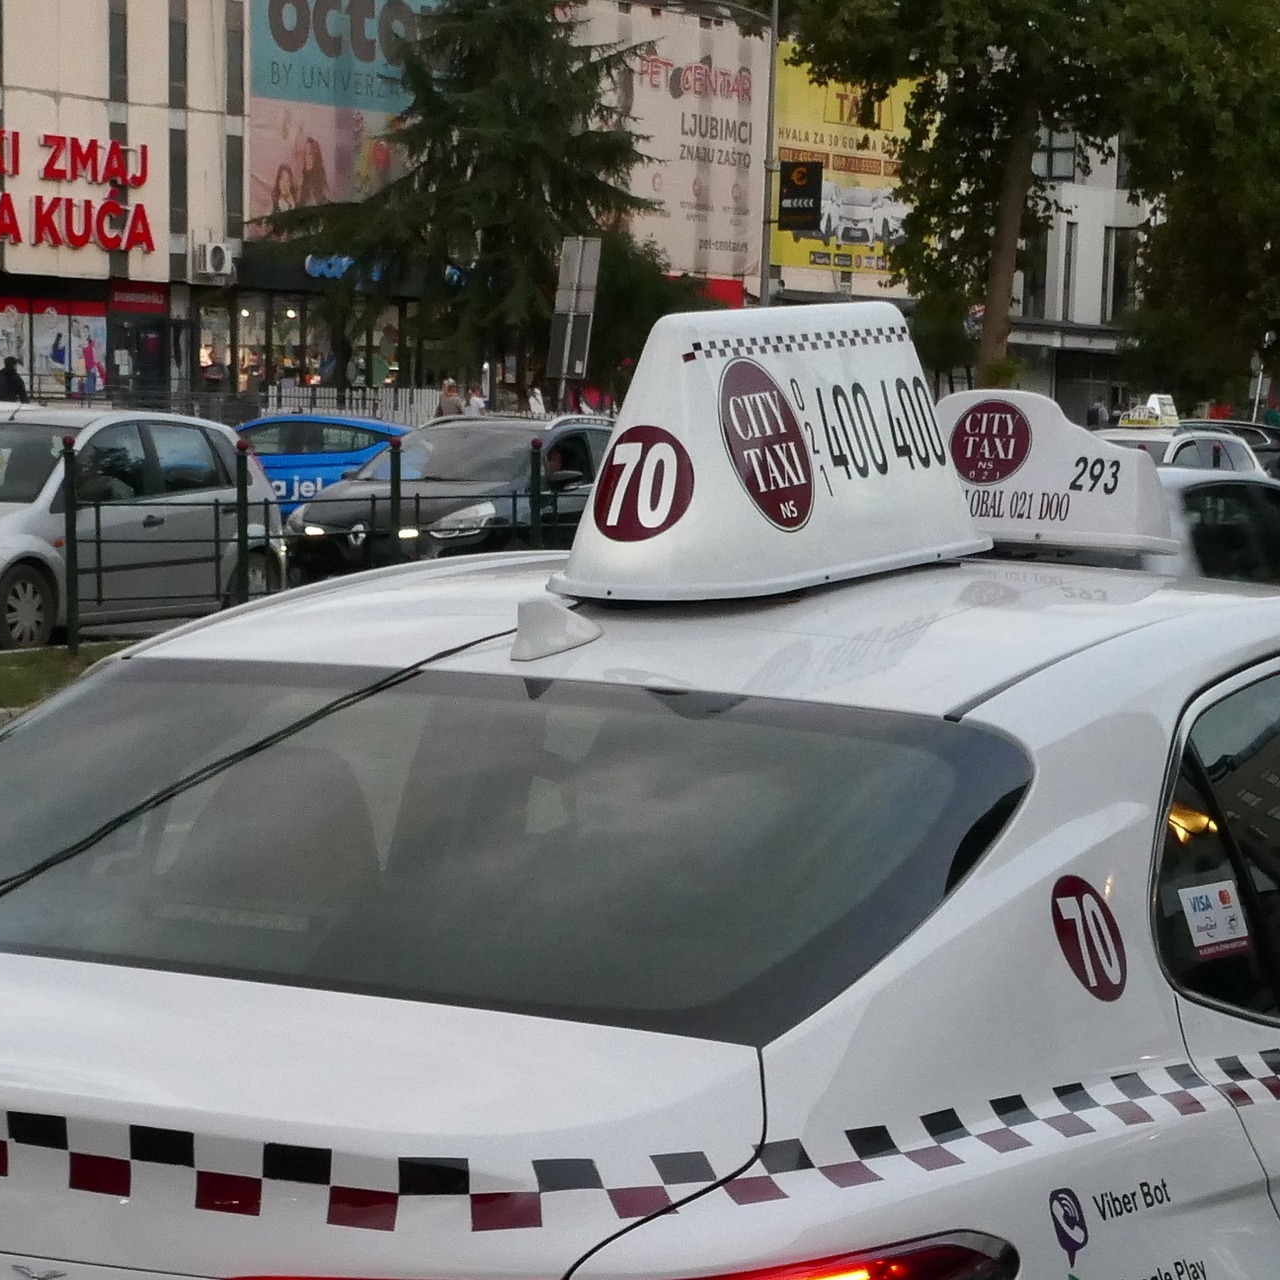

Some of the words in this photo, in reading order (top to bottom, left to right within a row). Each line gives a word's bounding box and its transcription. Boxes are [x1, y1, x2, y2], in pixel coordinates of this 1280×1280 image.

[270, 61, 293, 85] BY
[639, 55, 673, 92] PET
[680, 112, 752, 145] LJUBIMCI
[835, 92, 882, 129] TAI
[778, 127, 810, 142] HVALA
[813, 132, 825, 145] ZA
[39, 134, 149, 188] ZMAJ
[680, 144, 715, 163] ZNAJU
[717, 148, 751, 170] ZAŠTO
[33, 187, 155, 253] KUĆA
[729, 389, 789, 442] CITY
[815, 382, 888, 482] 400
[879, 375, 947, 471] 400
[965, 412, 1019, 436] CITY
[963, 436, 1016, 460] TAXI
[977, 460, 994, 470] NS
[606, 441, 678, 529] 70
[743, 441, 807, 493] TAXI
[1069, 456, 1121, 495] 293
[778, 500, 799, 520] NS
[1009, 491, 1032, 519] 021
[1038, 492, 1070, 521] DOO
[1188, 895, 1213, 913] VISA
[1056, 893, 1121, 987] 70
[1092, 1190, 1138, 1221] Viber
[1139, 1178, 1171, 1208] Bot
